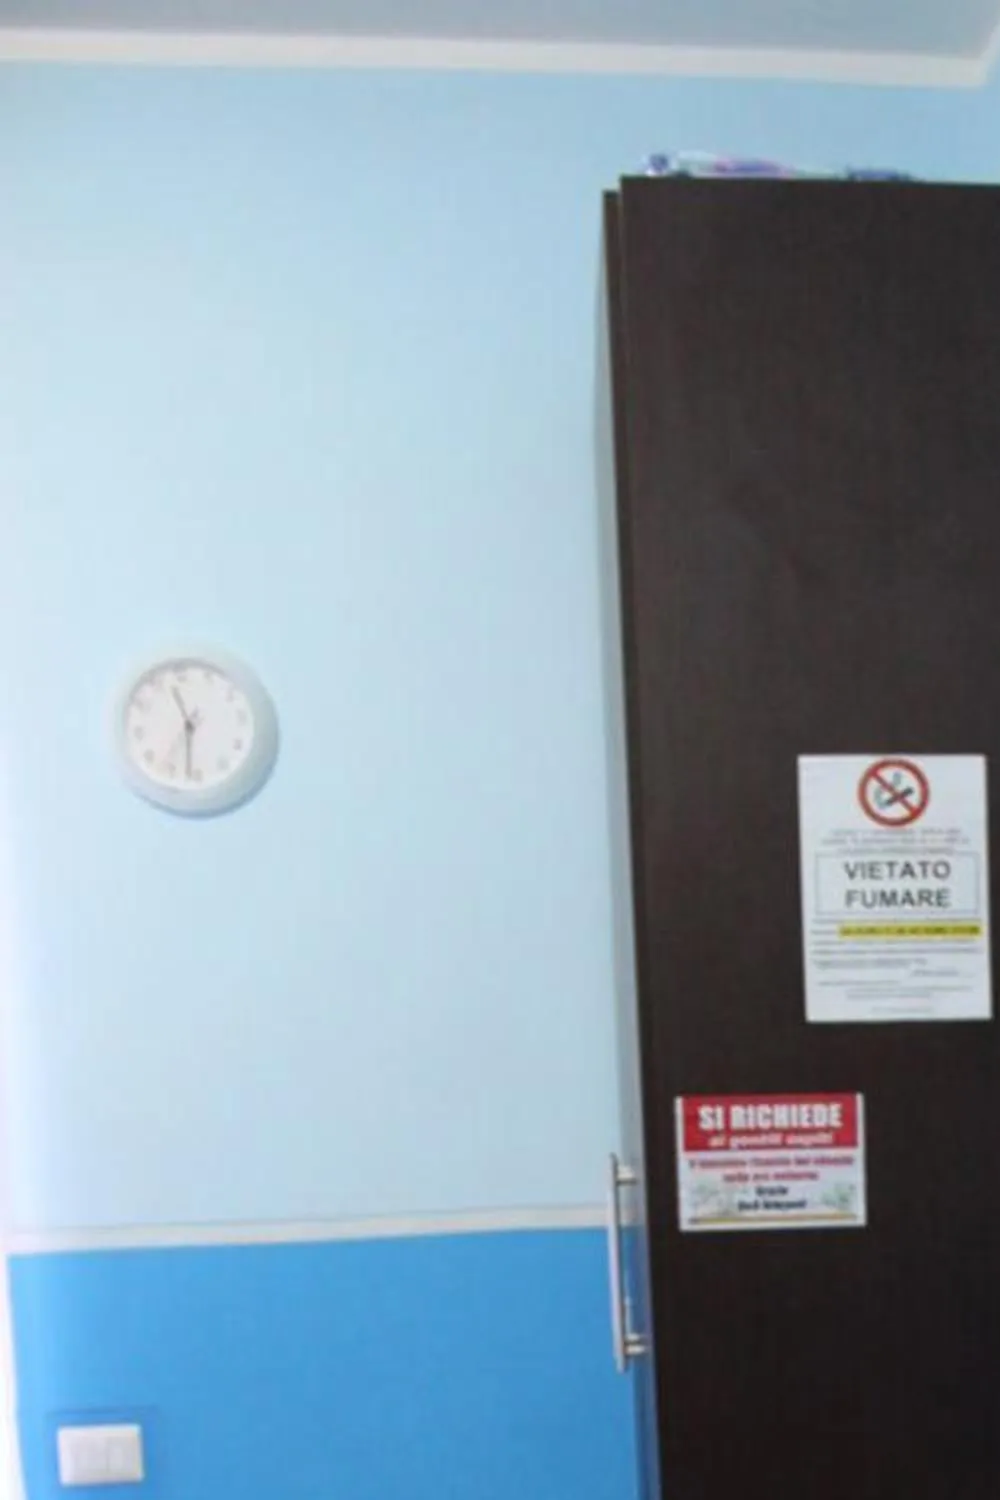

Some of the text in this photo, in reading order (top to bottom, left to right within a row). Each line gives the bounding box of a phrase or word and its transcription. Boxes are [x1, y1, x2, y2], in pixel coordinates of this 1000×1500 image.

[844, 861, 951, 881] VIETATO
[845, 888, 951, 909] FUMARE
[697, 1102, 843, 1131] SI RICHIEDE
